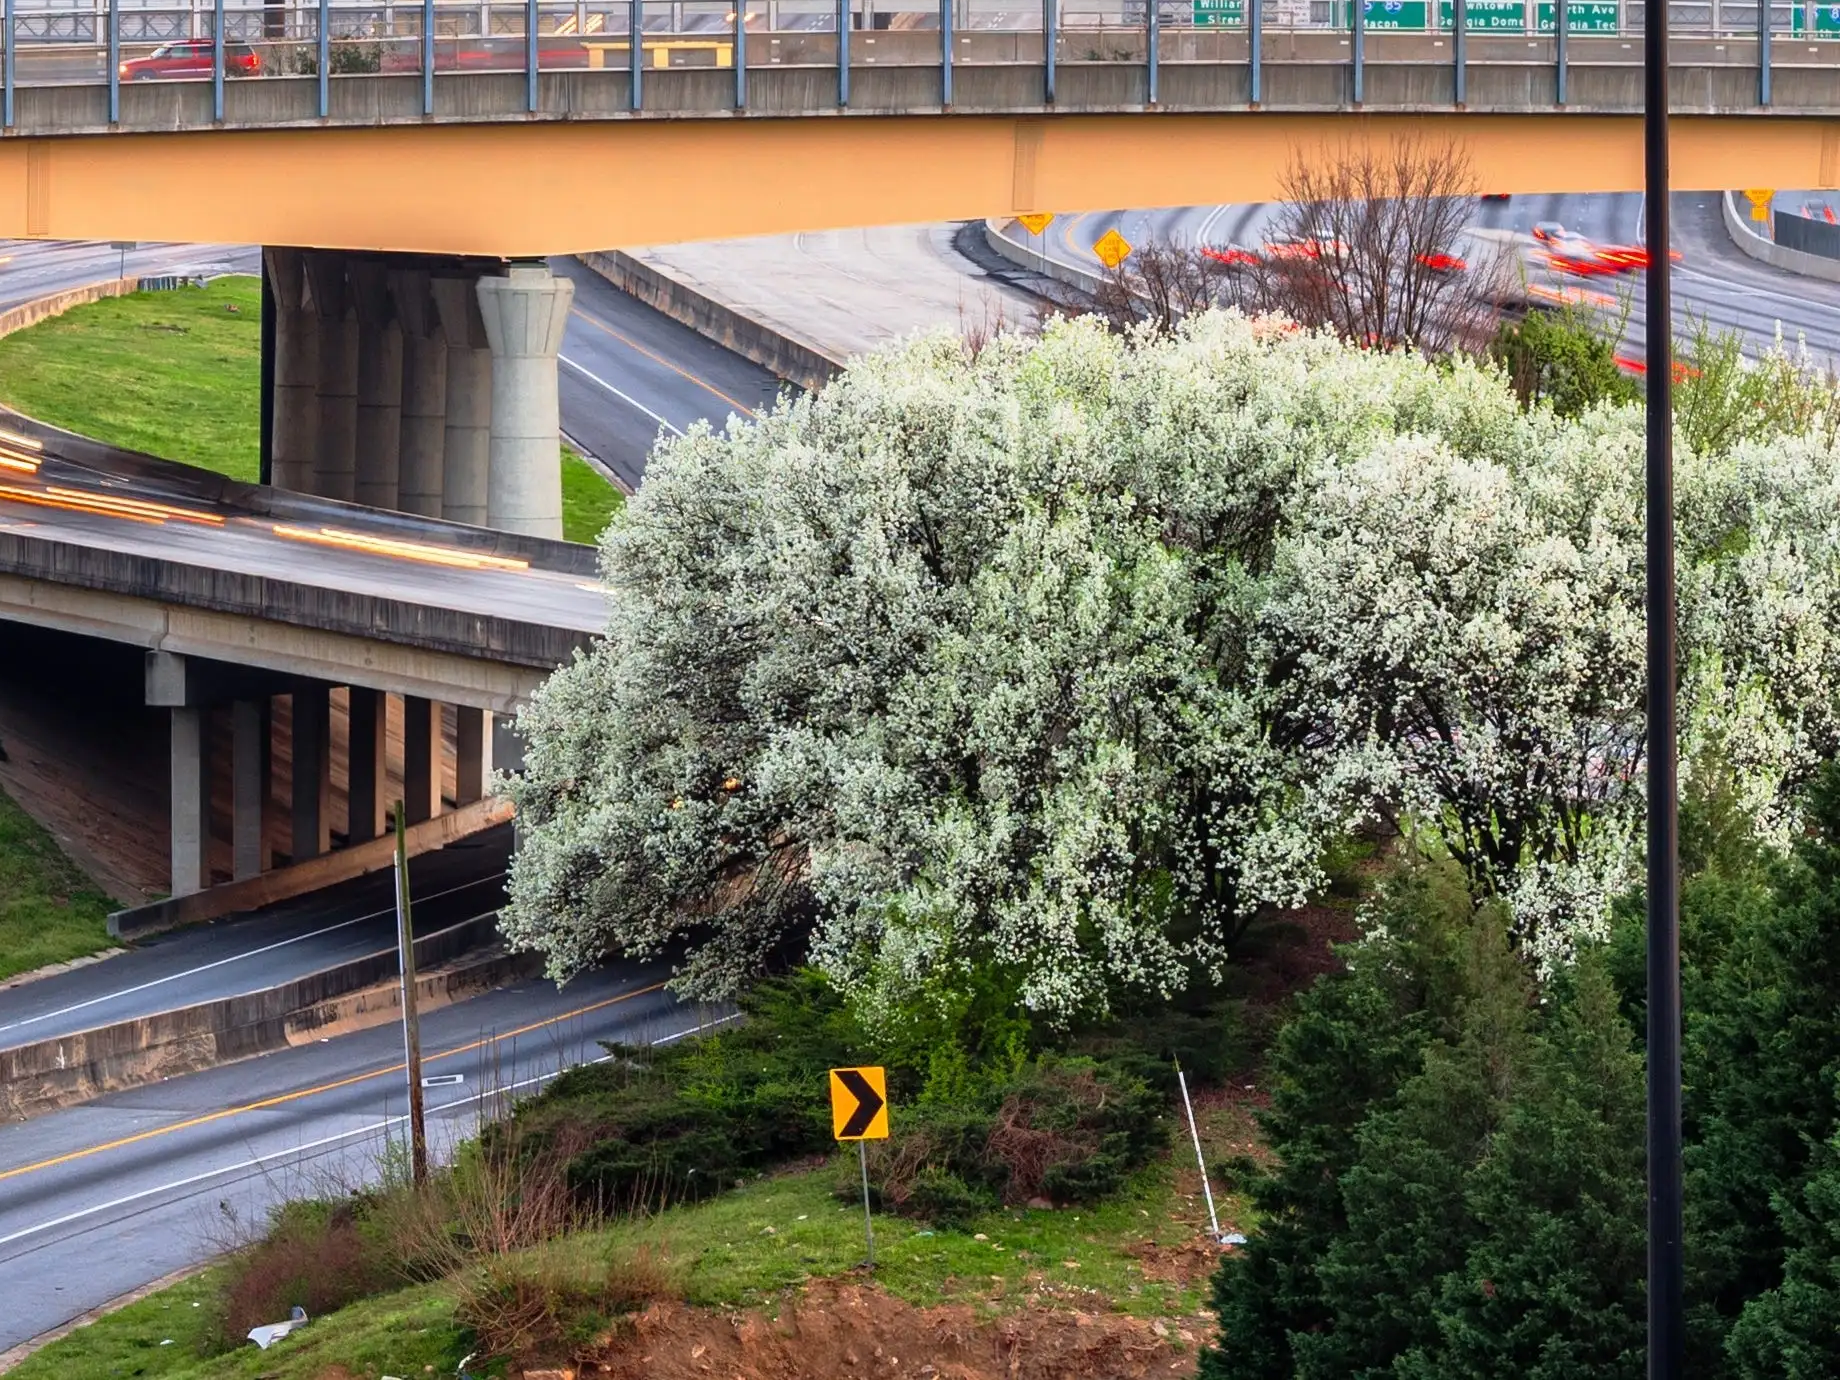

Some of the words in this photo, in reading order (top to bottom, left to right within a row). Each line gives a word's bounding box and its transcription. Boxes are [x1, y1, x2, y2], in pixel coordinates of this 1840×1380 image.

[1384, 0, 1402, 11] 85
[1549, 5, 1585, 15] Nrth
[1591, 5, 1615, 15] Ave
[1207, 15, 1241, 25] Sree
[1540, 20, 1588, 30] Gegia
[1595, 20, 1617, 30] Tec
